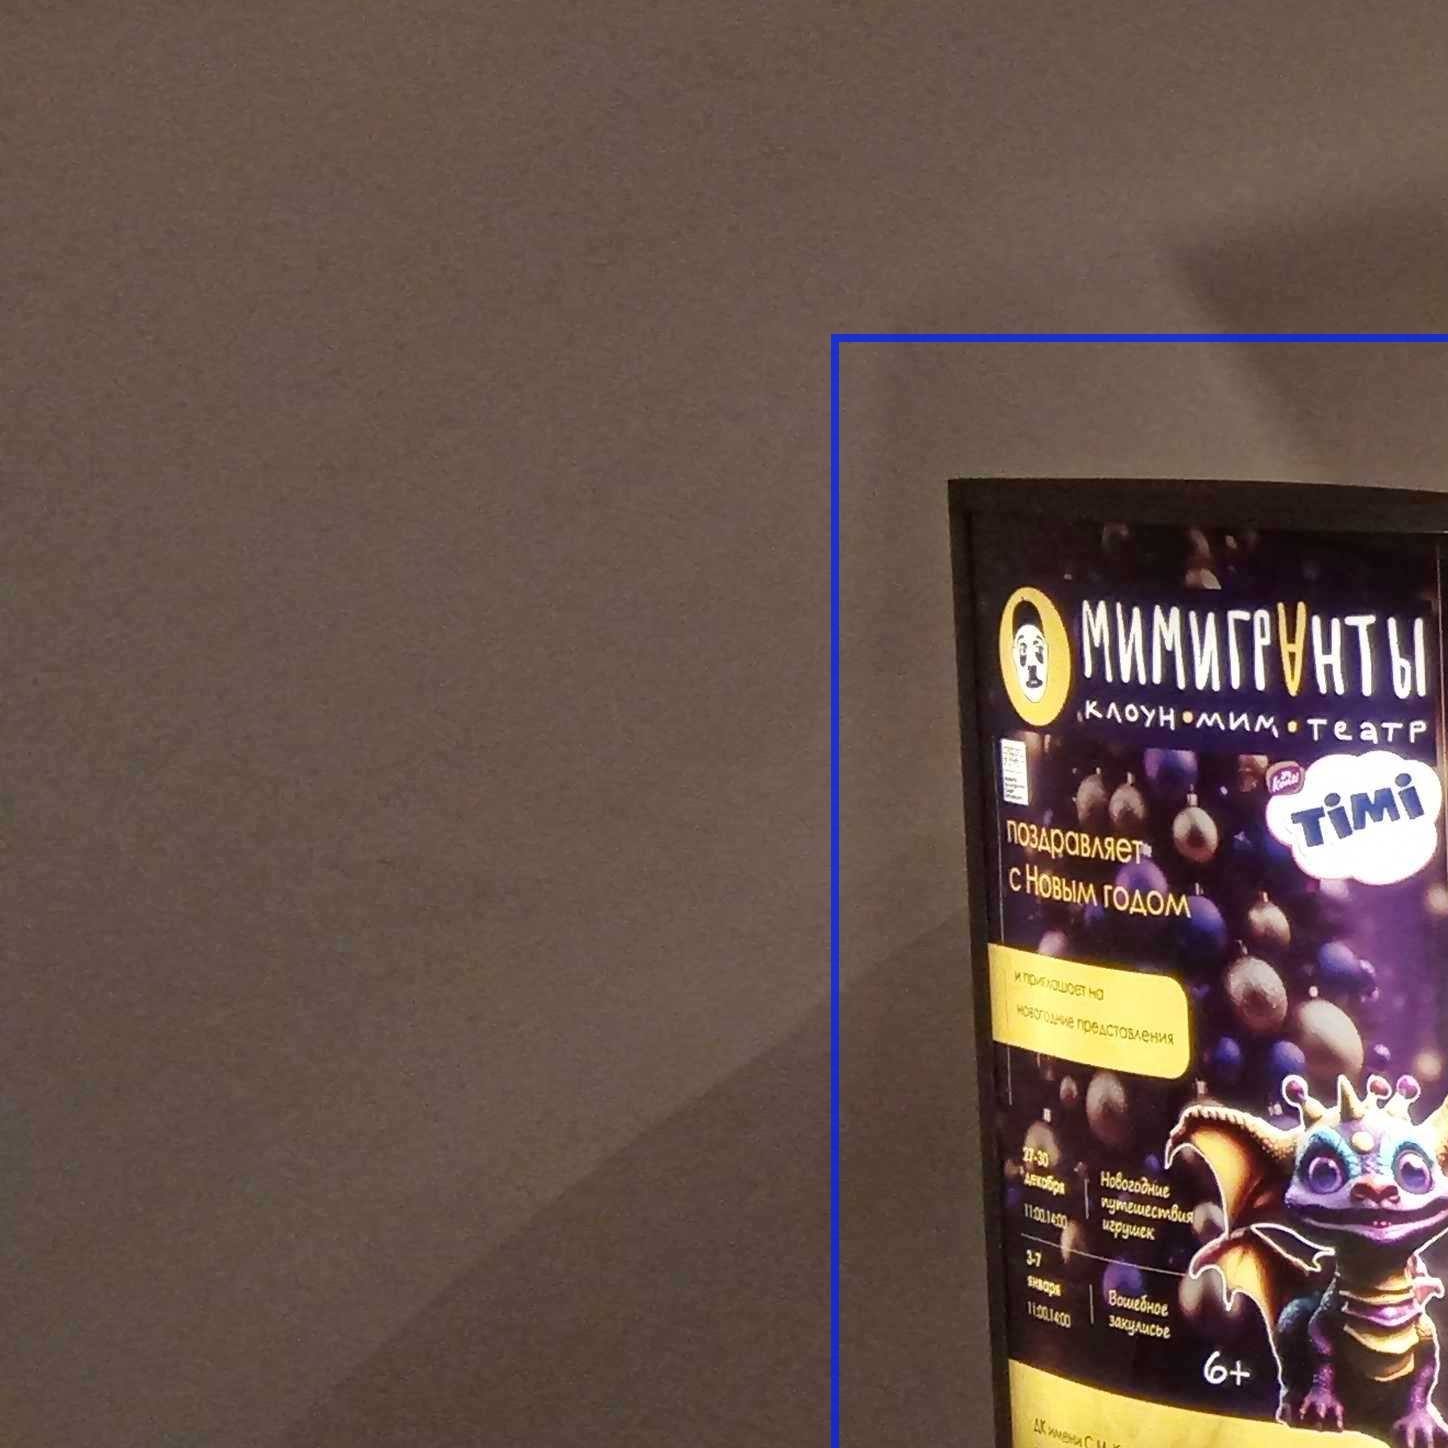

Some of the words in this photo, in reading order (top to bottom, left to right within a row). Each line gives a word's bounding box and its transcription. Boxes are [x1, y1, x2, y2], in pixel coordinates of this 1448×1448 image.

[1083, 600, 1426, 698] МИМИГРАНТЫ
[1007, 819, 1143, 864] поздравляет
[1009, 867, 1021, 891] с
[1025, 864, 1097, 906] Новым
[1103, 884, 1191, 918] годом
[1089, 988, 1104, 1000] на
[1077, 1019, 1174, 1045] представления
[1101, 1171, 1170, 1198] Новогодние
[1101, 1197, 1194, 1224] путешествия
[1103, 1218, 1155, 1240] игрушек
[1026, 1249, 1042, 1267] 3-7
[1108, 1289, 1169, 1317] Вошебное
[1108, 1314, 1171, 1339] закулисье
[1203, 1351, 1250, 1386] 6+
